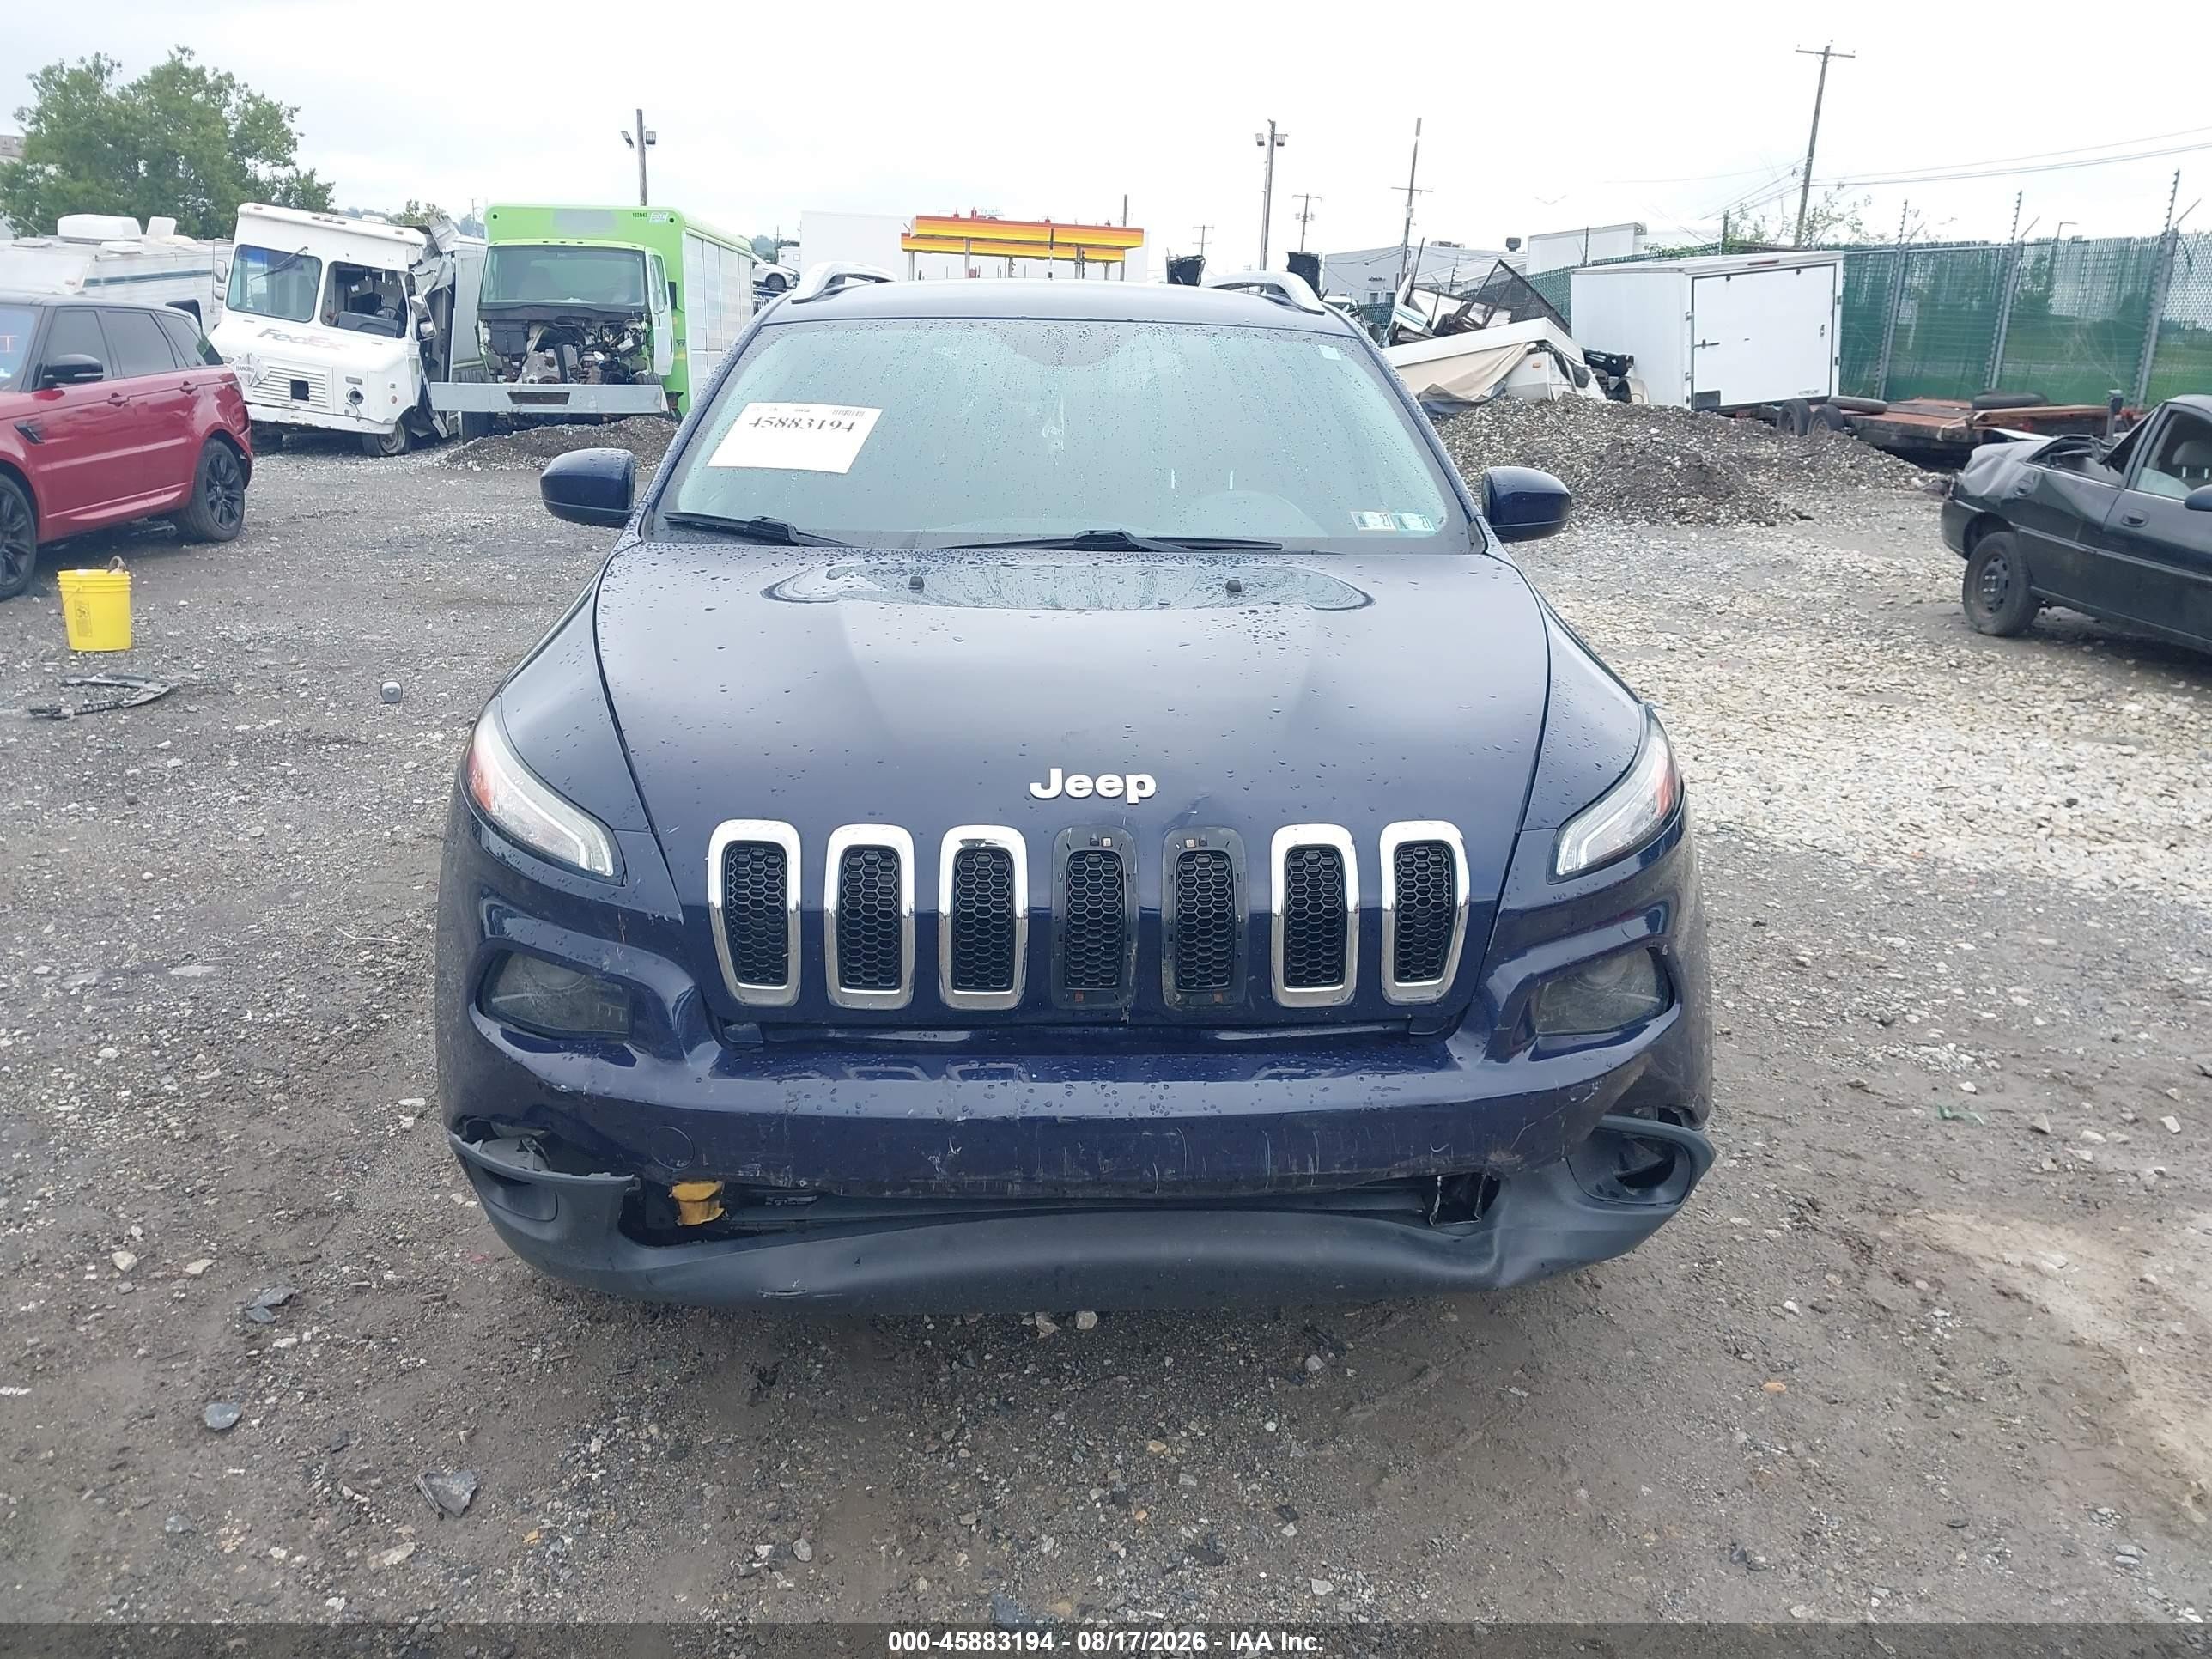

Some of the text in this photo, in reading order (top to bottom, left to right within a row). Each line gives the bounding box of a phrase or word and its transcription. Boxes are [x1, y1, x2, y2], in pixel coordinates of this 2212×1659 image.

[257, 328, 351, 351] FedEx
[748, 416, 855, 432] 45883194
[1030, 768, 1157, 805] Jeep
